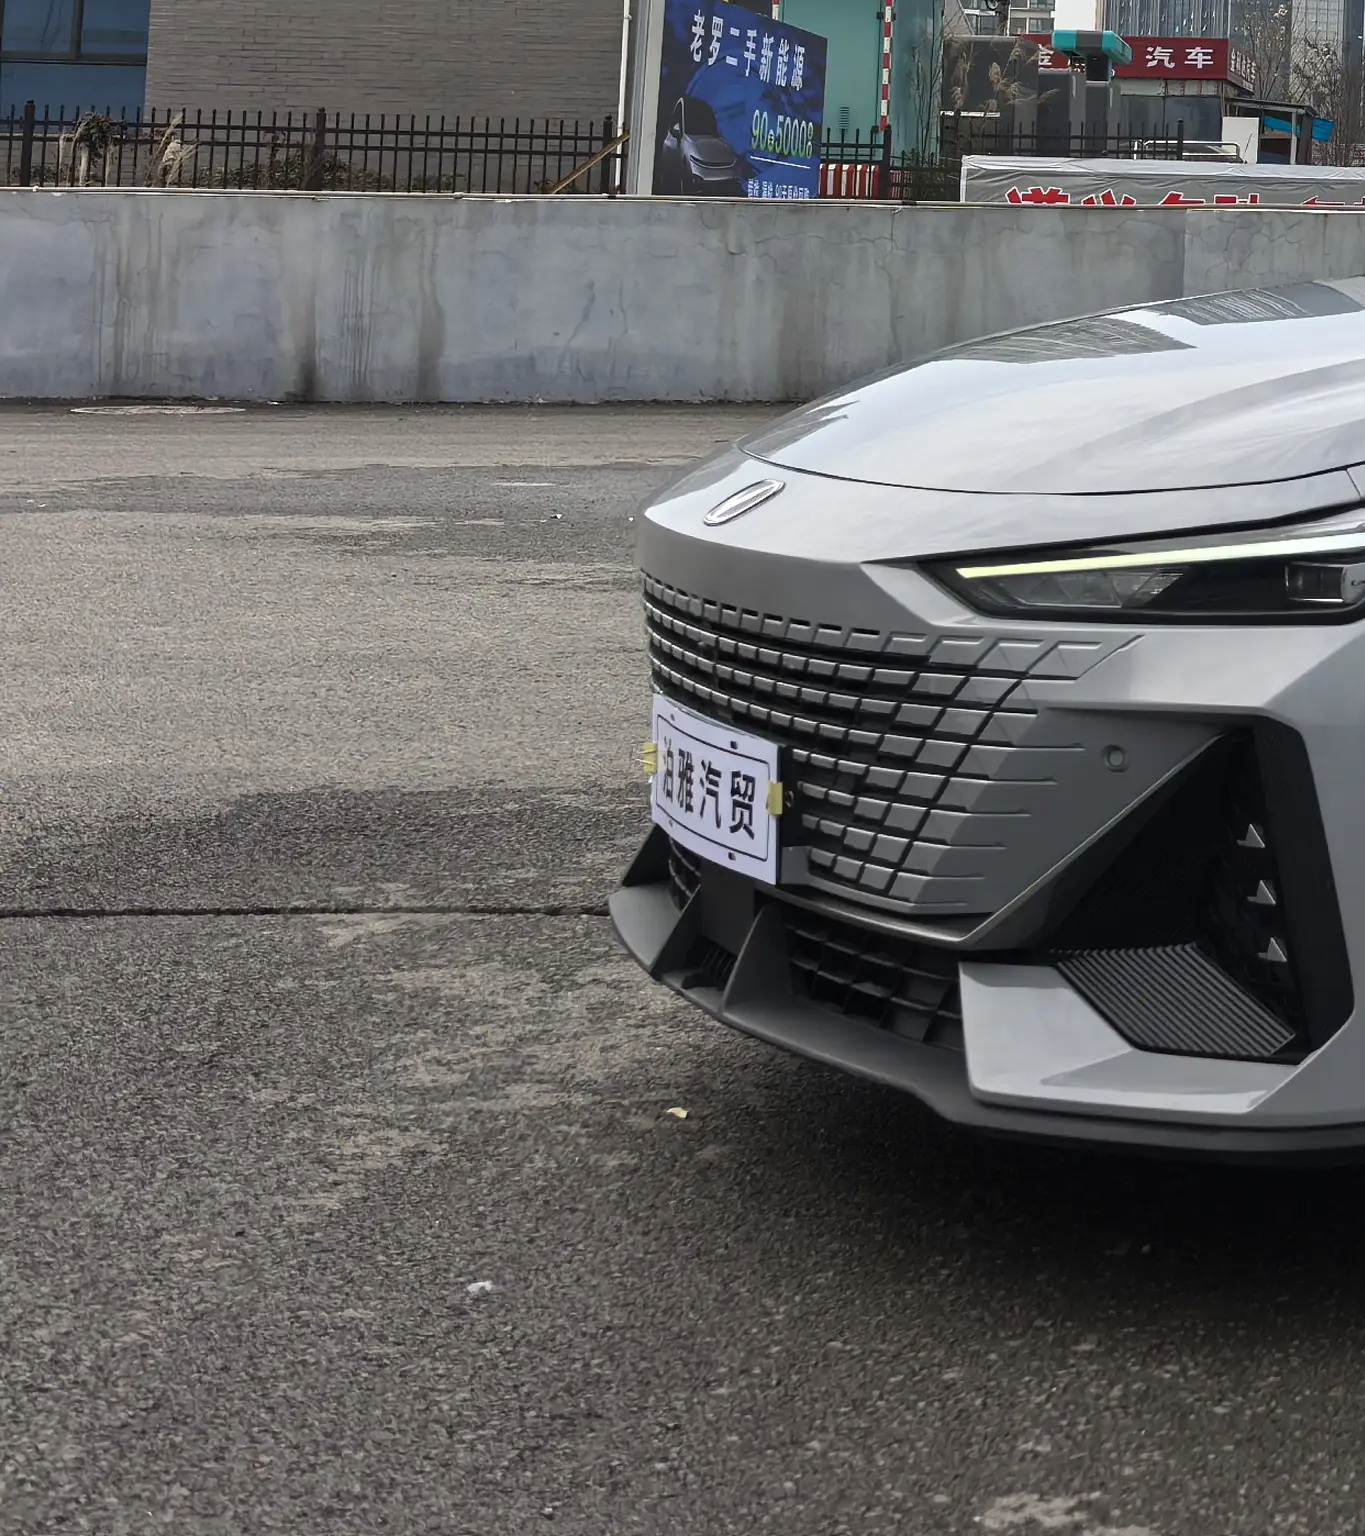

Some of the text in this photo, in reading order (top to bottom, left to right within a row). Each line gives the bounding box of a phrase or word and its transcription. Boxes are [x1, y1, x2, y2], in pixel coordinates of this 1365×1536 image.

[690, 10, 806, 91] 老罗二手新能源
[663, 735, 756, 840] 泊雅汽贸
